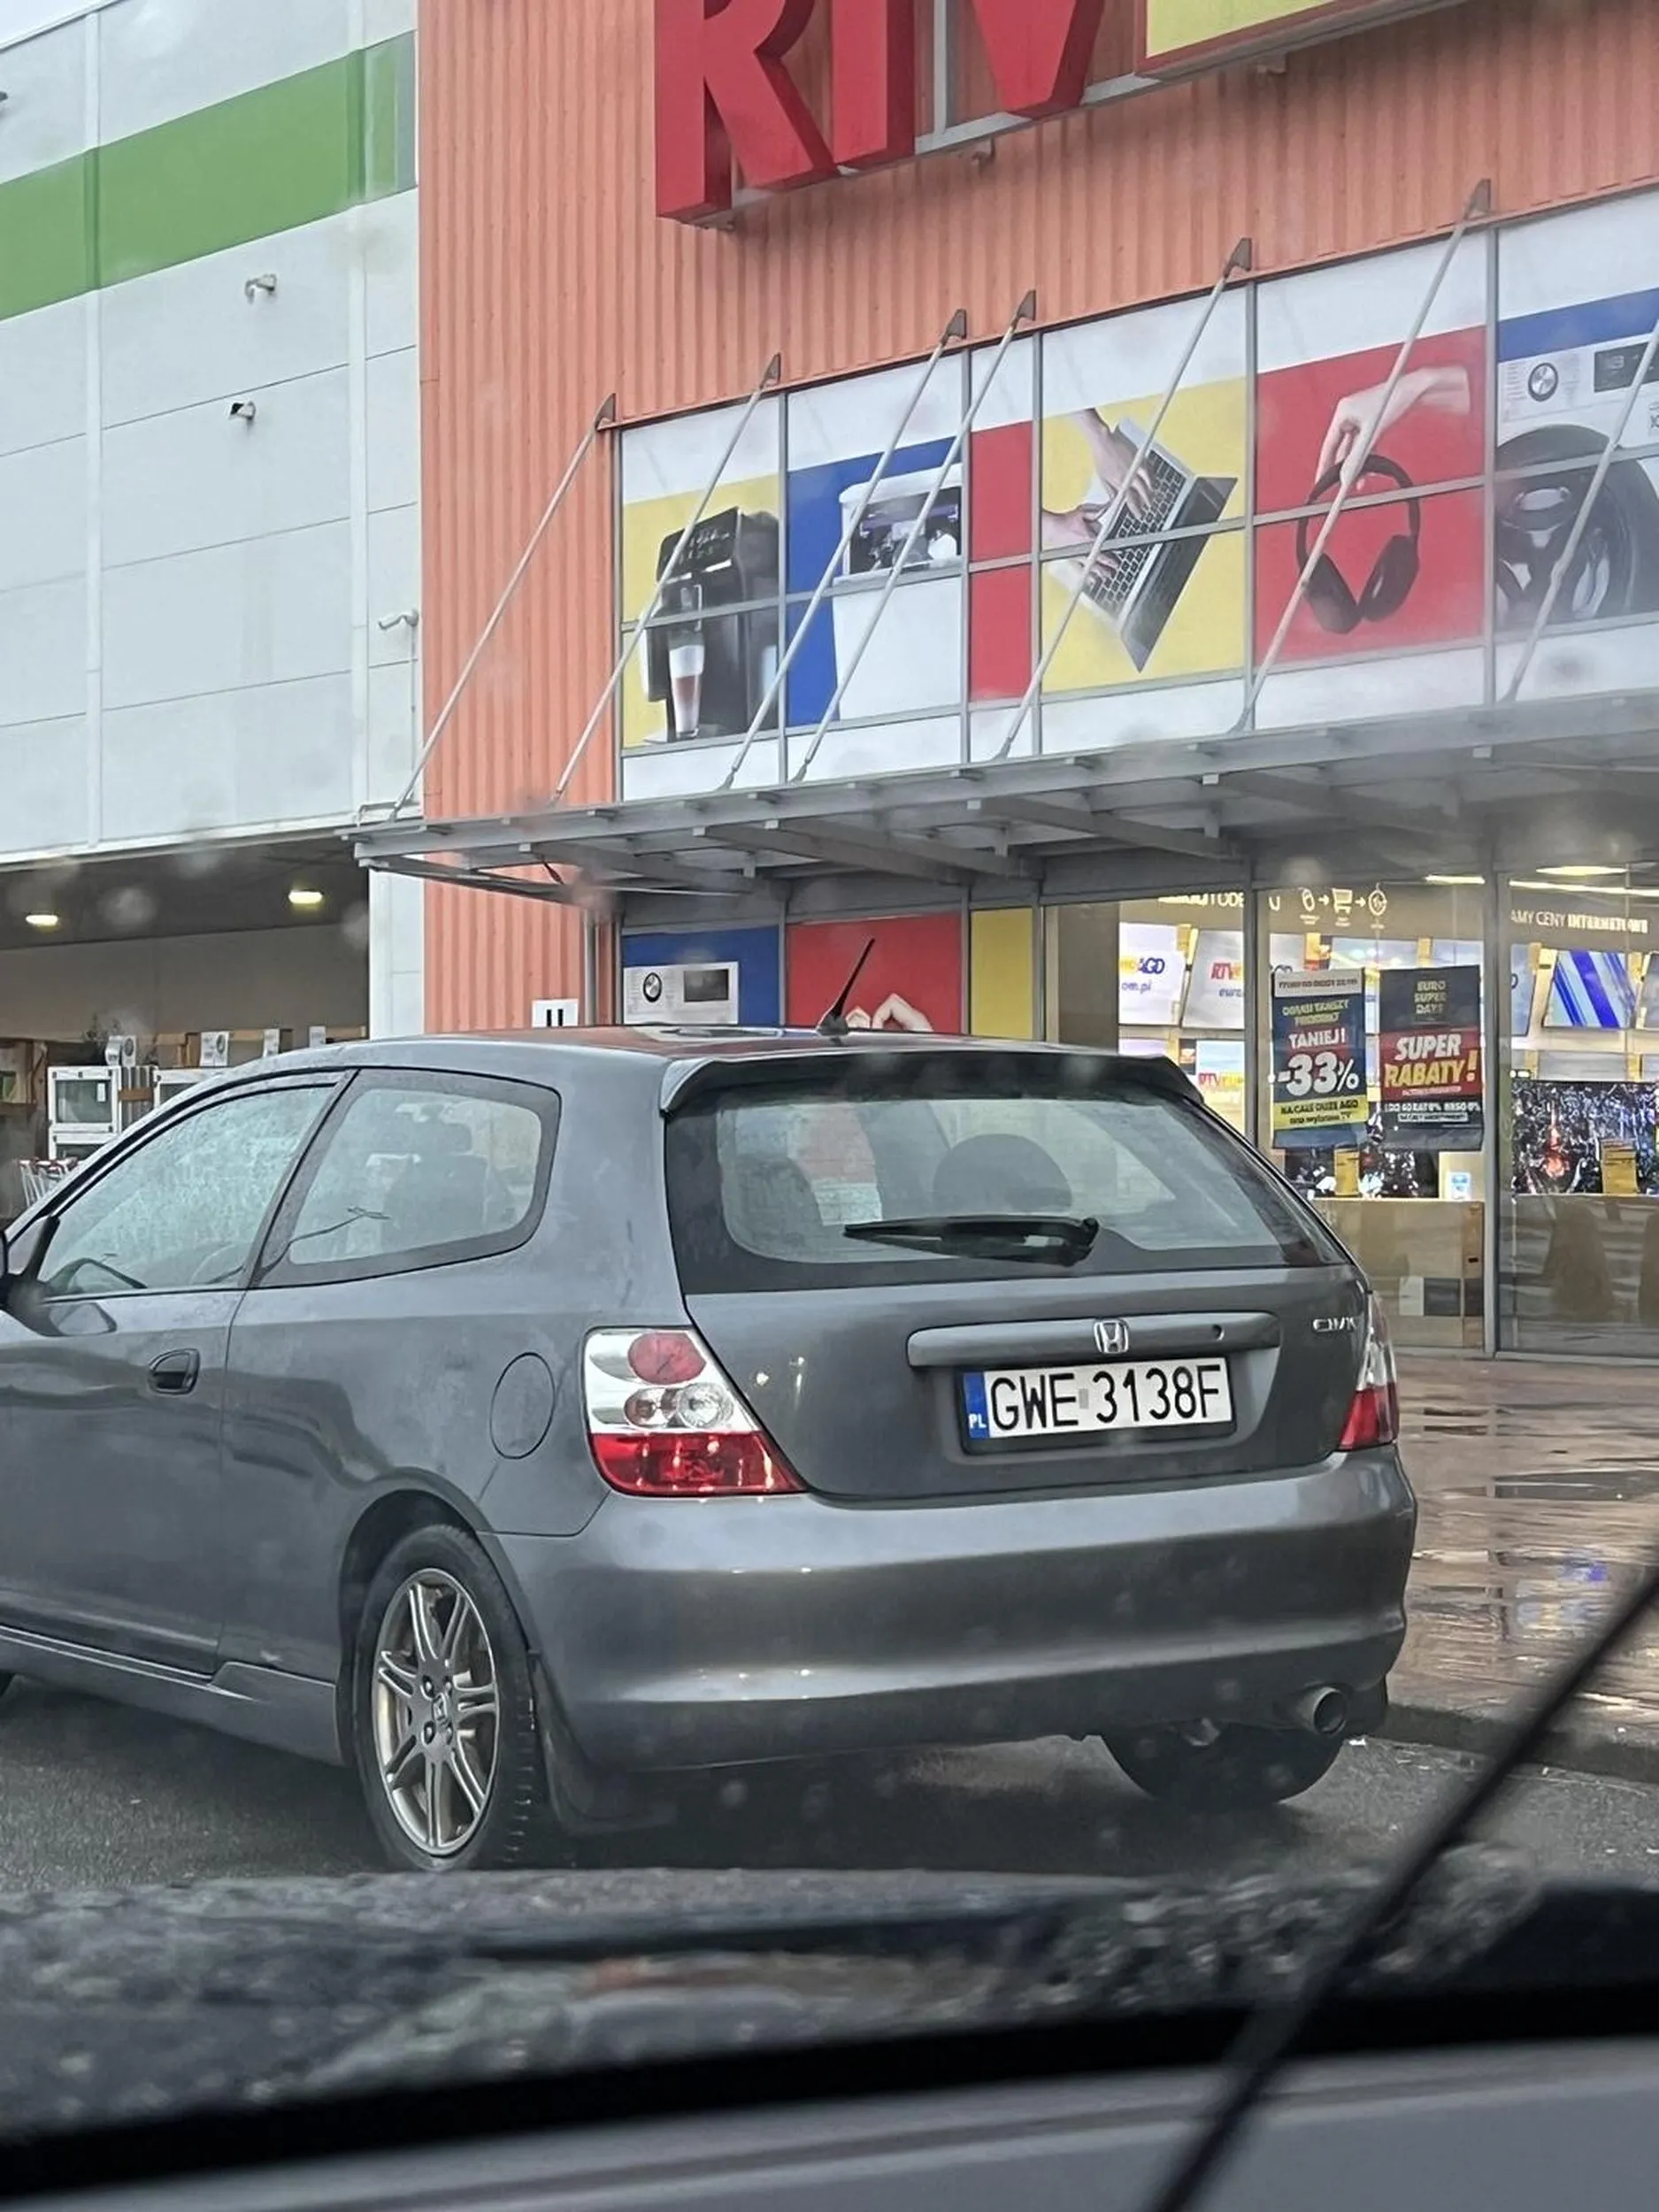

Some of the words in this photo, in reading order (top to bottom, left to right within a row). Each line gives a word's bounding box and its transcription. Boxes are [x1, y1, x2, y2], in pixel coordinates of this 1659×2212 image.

[1288, 1027, 1346, 1048] TANIEJ!
[1395, 1033, 1462, 1062] SUPER
[1277, 1051, 1359, 1096] -33%
[1384, 1049, 1479, 1088] RABATY!
[990, 1371, 1078, 1431] GWE
[1092, 1363, 1222, 1423] 3138F
[969, 1412, 987, 1429] PL
